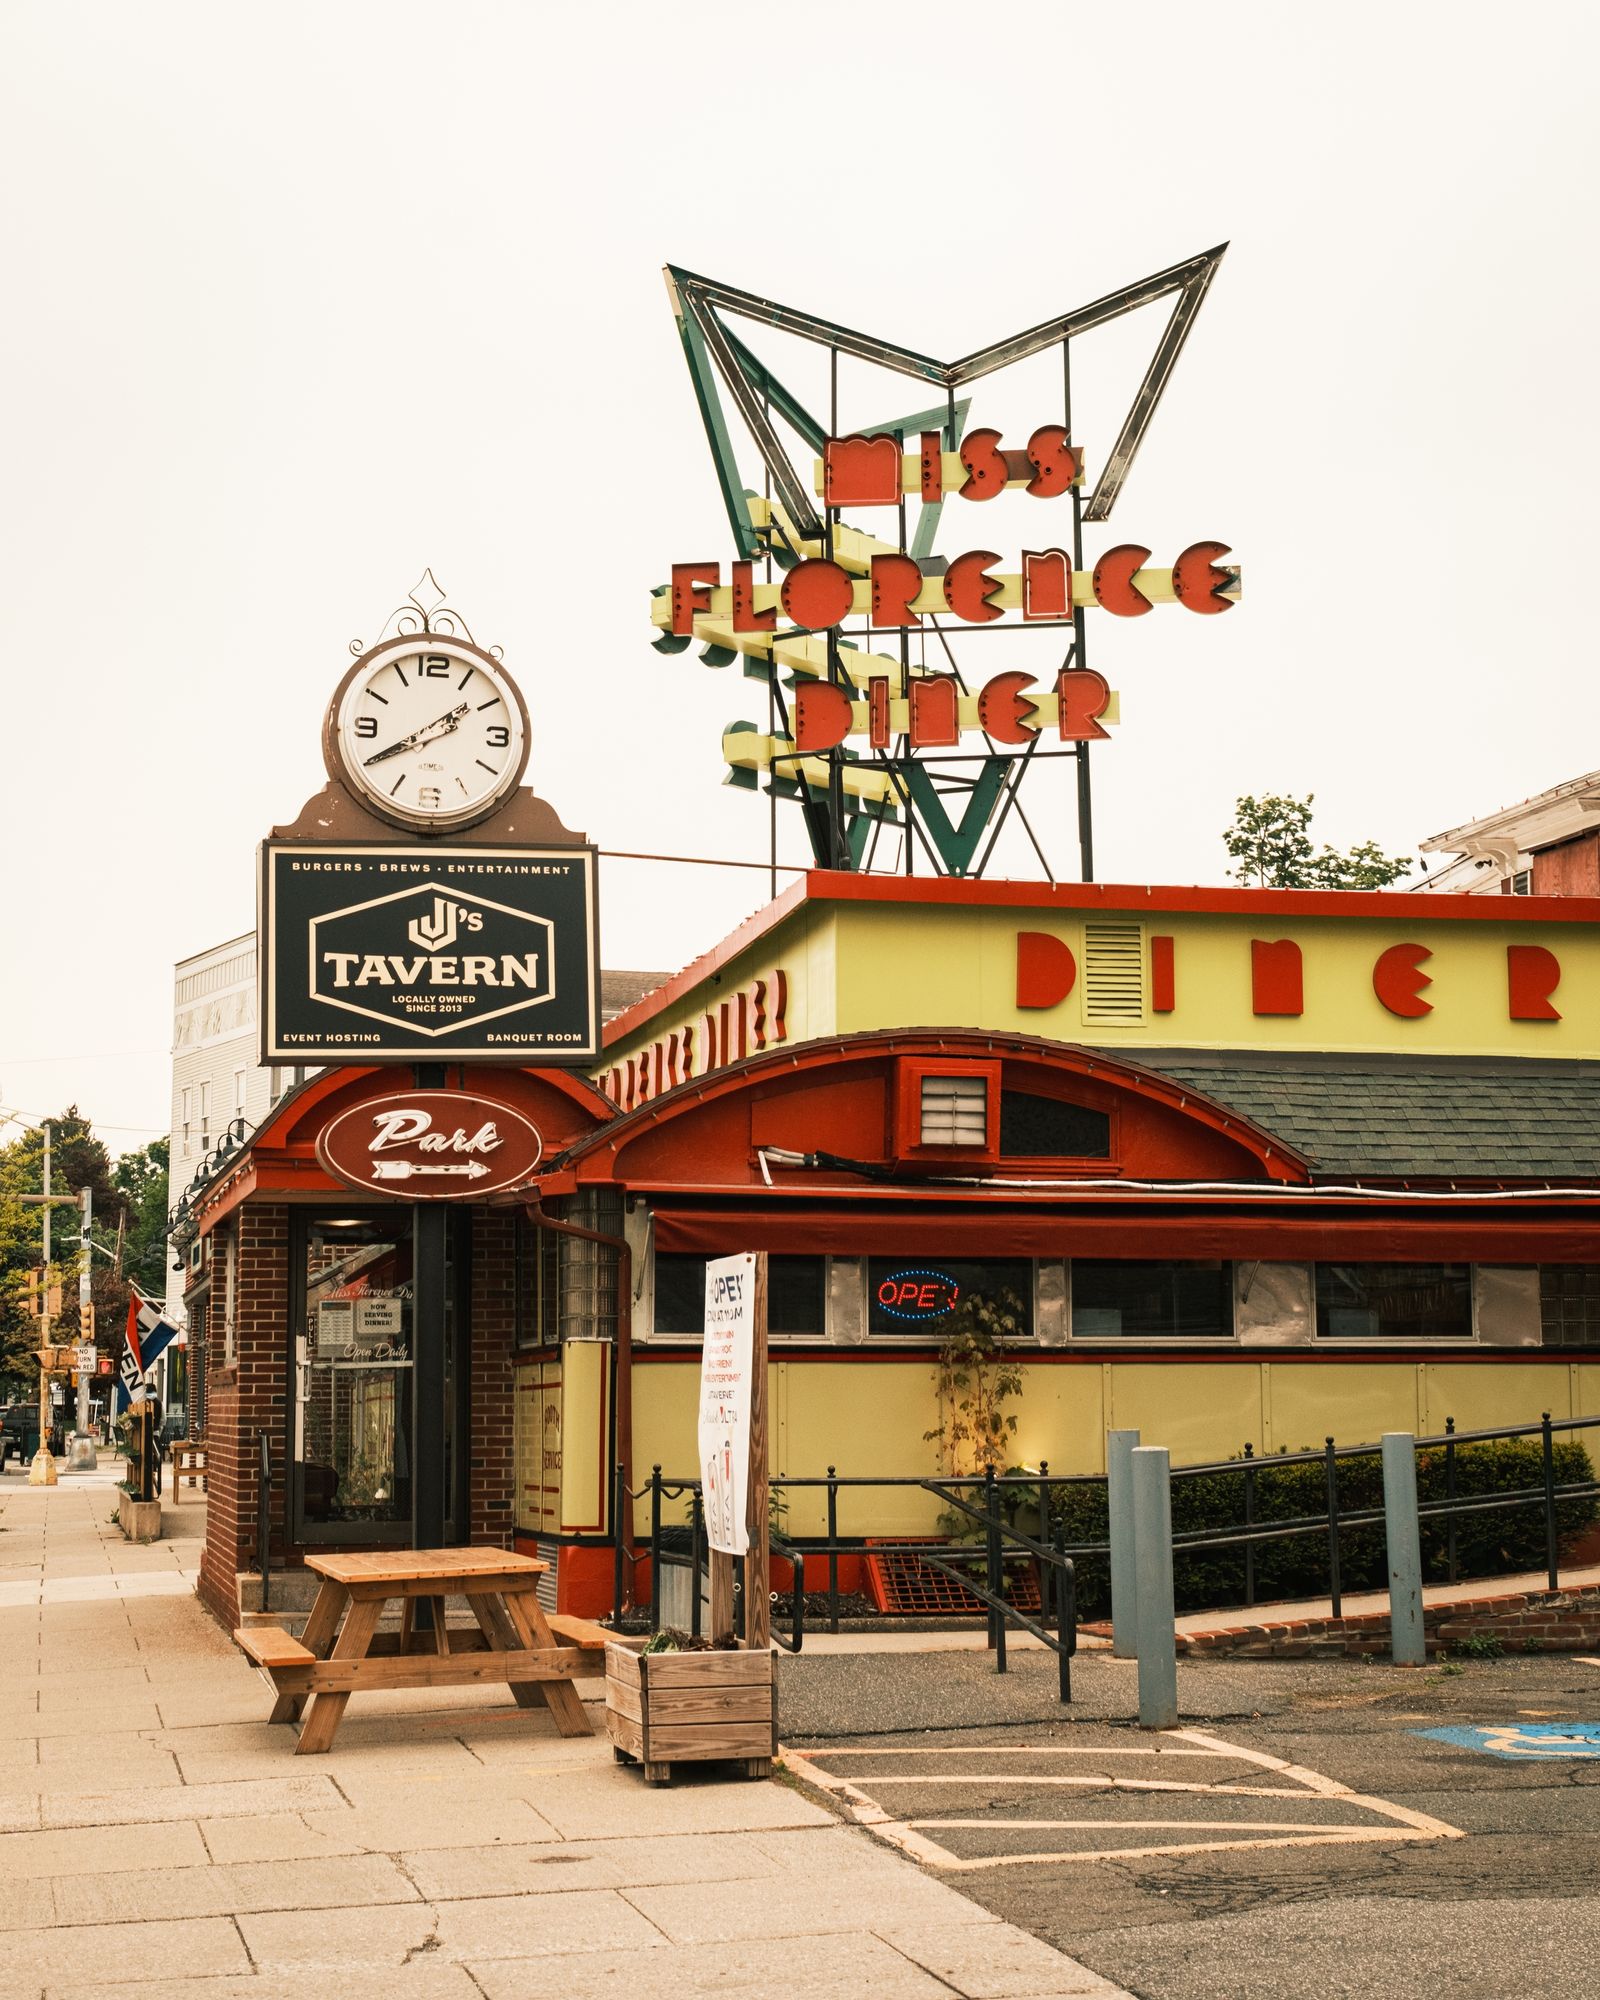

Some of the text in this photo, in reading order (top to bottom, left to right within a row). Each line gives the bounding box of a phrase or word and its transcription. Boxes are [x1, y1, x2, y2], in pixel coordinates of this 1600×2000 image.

[822, 425, 1076, 507] MISS
[671, 541, 1236, 636] FLORENCE
[418, 655, 450, 678] 12
[795, 668, 1112, 752] DINER
[354, 716, 378, 739] 9
[486, 726, 509, 748] 3
[292, 862, 571, 876] BURGERS BREWS ENTERTAINMENT
[323, 952, 539, 989] TAVERN
[1016, 931, 1563, 1021] DINER
[392, 995, 476, 1004] LOCALLY OWNED
[406, 1004, 463, 1013] SINCE 2013
[283, 1033, 381, 1042] EVENT HOSTING
[487, 1033, 582, 1043] BANQUET ROOM
[368, 1109, 504, 1153] Park
[343, 1342, 408, 1361] Open Daily
[545, 1450, 562, 1470] ERVICE
